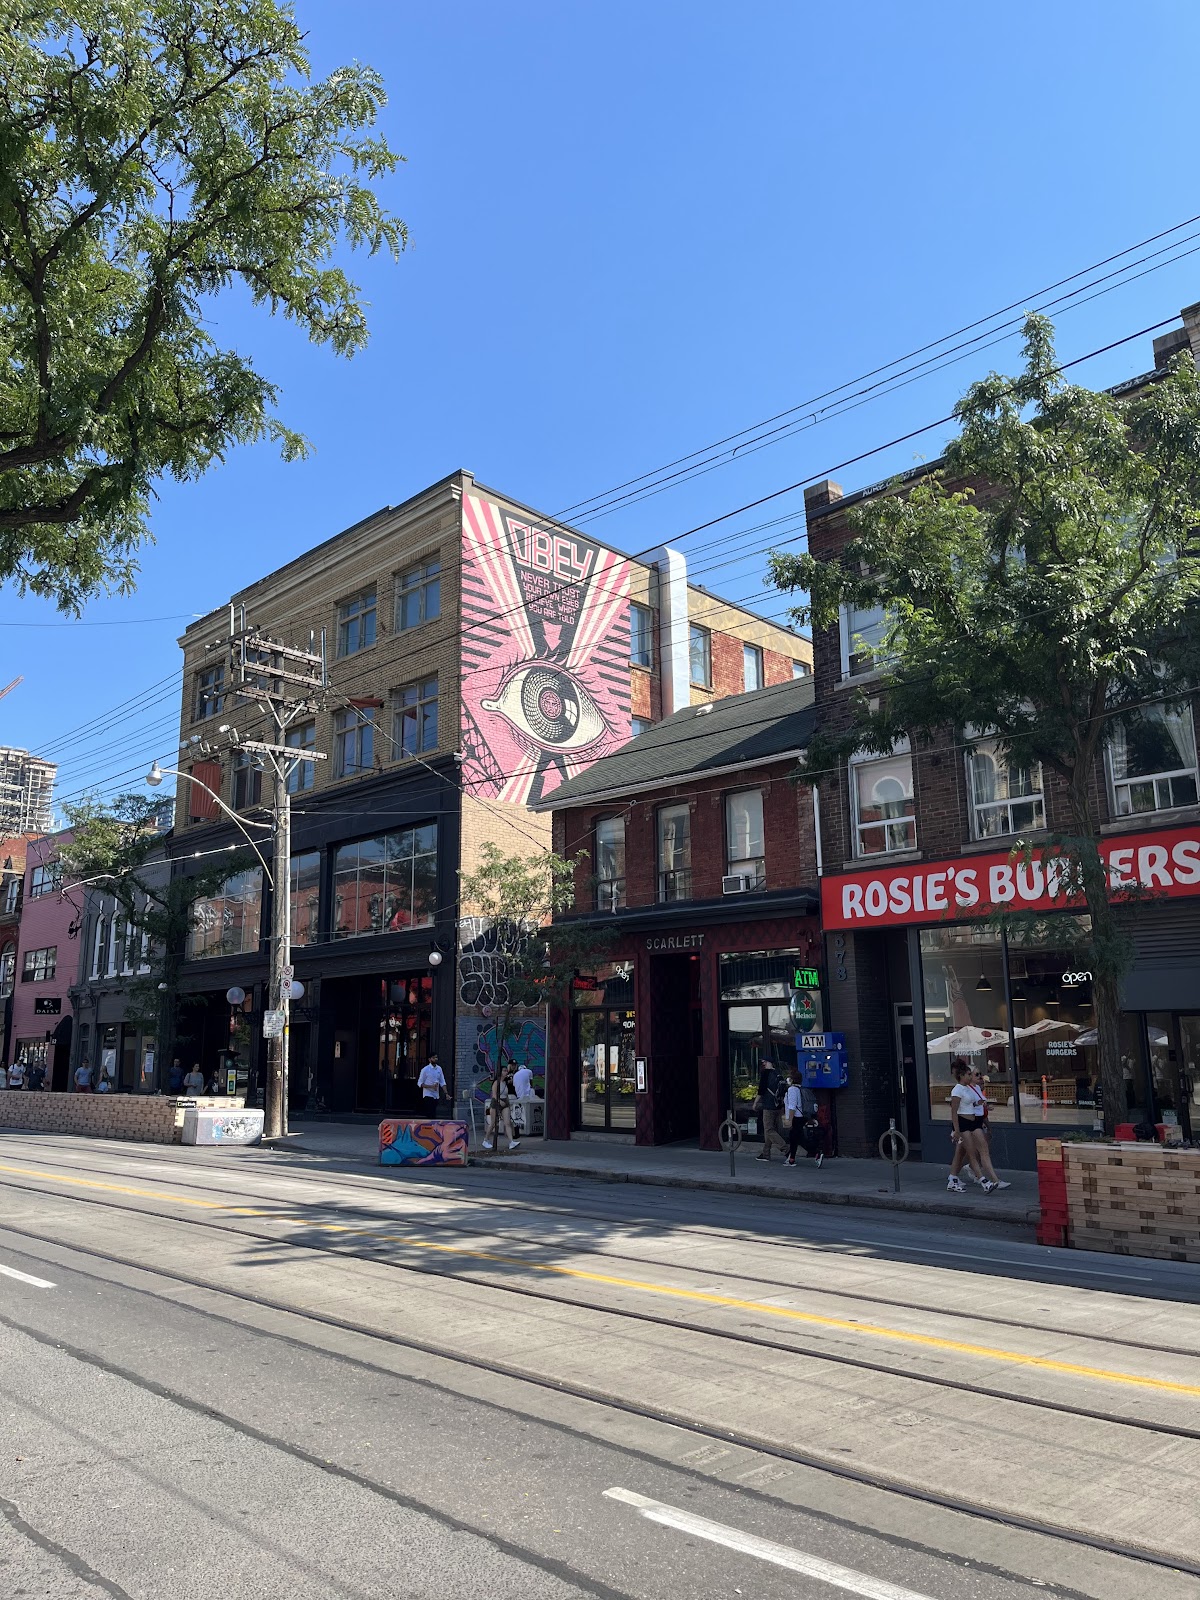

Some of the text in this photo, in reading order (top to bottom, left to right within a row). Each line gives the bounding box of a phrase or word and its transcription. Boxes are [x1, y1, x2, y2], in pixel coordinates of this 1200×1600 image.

[505, 516, 594, 587] OBEY
[520, 570, 580, 599] NEVER TRUST
[523, 581, 579, 609] YOUR OWN EYES
[525, 592, 577, 617] BELIEVE WHAT
[528, 602, 575, 625] YOU ARE TOLD
[842, 840, 1200, 919] ROSIE'S BURERS
[646, 933, 705, 950] SCARLETT
[615, 964, 630, 983] open
[795, 969, 819, 987] ATM
[1061, 970, 1093, 985] open
[803, 1036, 825, 1048] ATM
[1048, 1040, 1075, 1048] ROSIE'S
[1046, 1048, 1078, 1056] BURGERS
